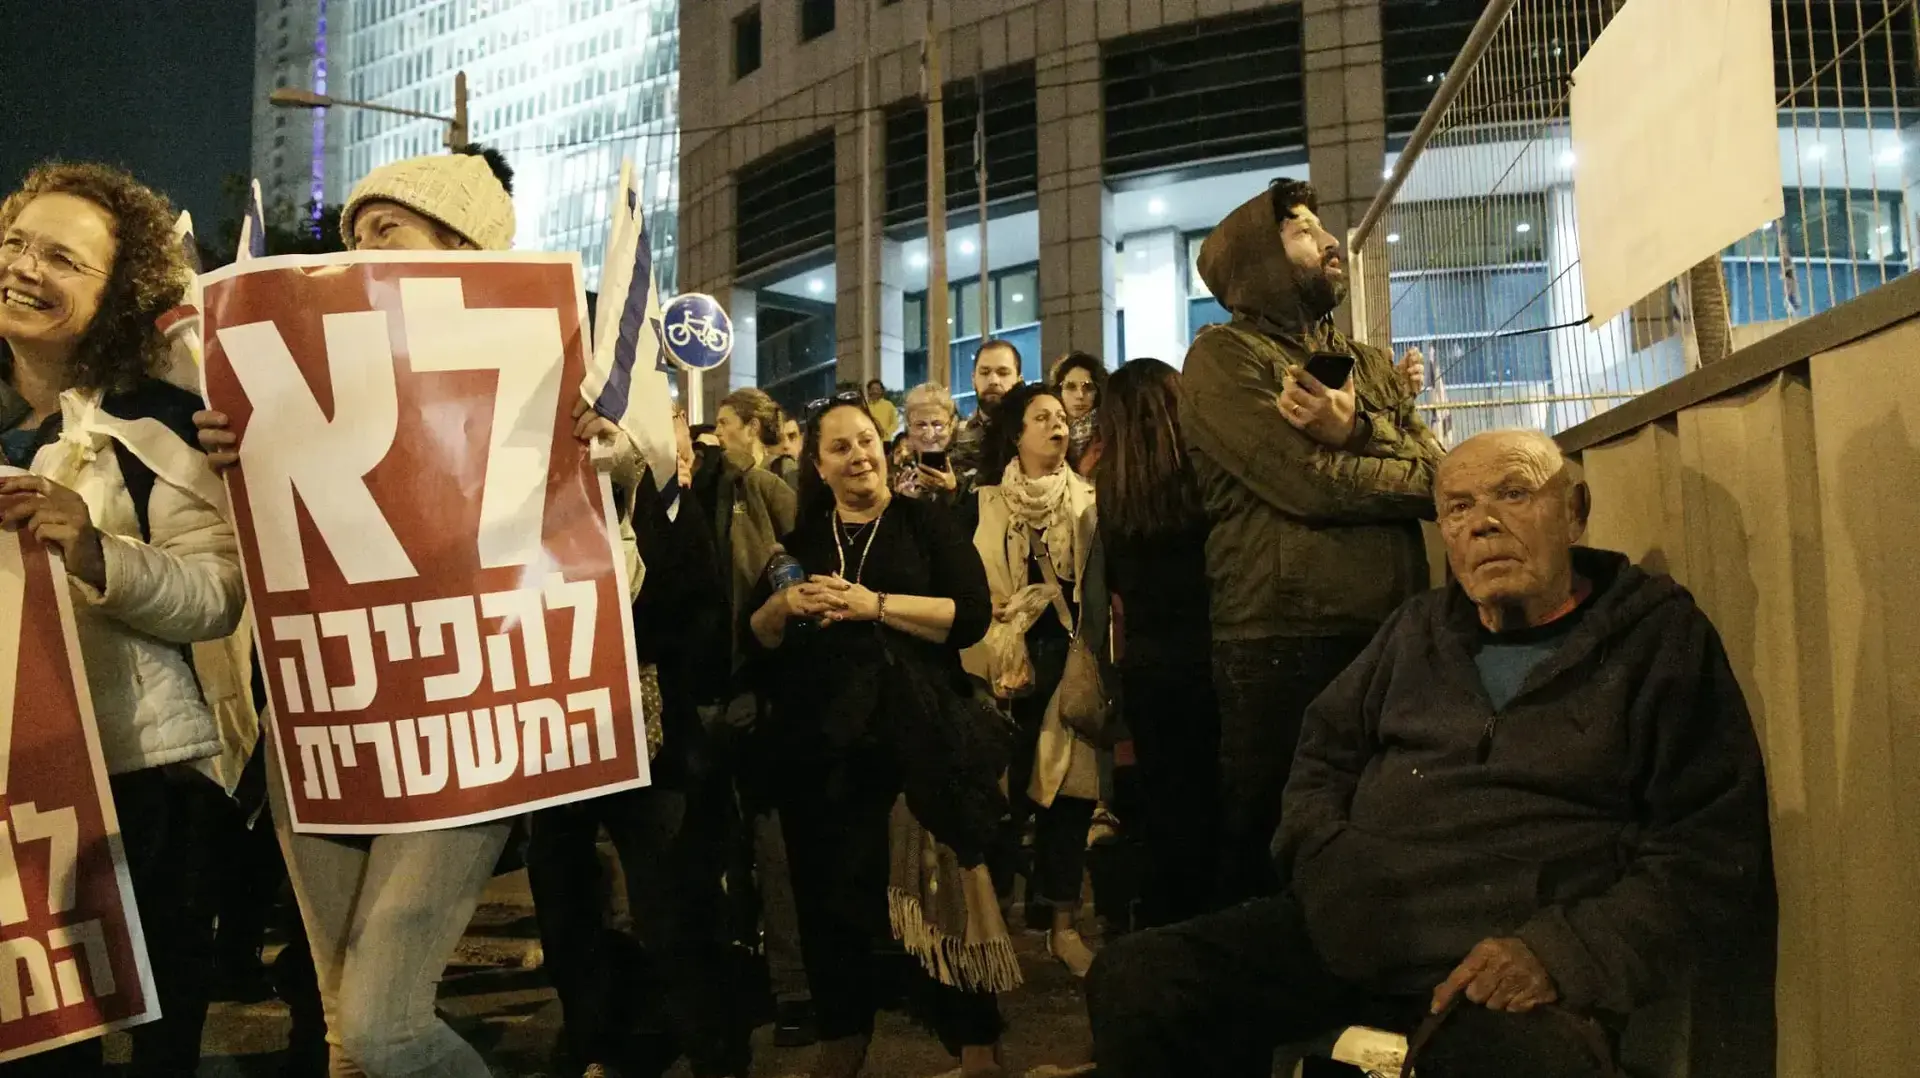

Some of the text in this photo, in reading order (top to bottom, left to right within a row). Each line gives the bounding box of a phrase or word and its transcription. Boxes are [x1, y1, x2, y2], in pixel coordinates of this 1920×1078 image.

[216, 277, 564, 593] לא
[271, 572, 598, 713] להפיכה
[294, 687, 617, 800] המשטרית
